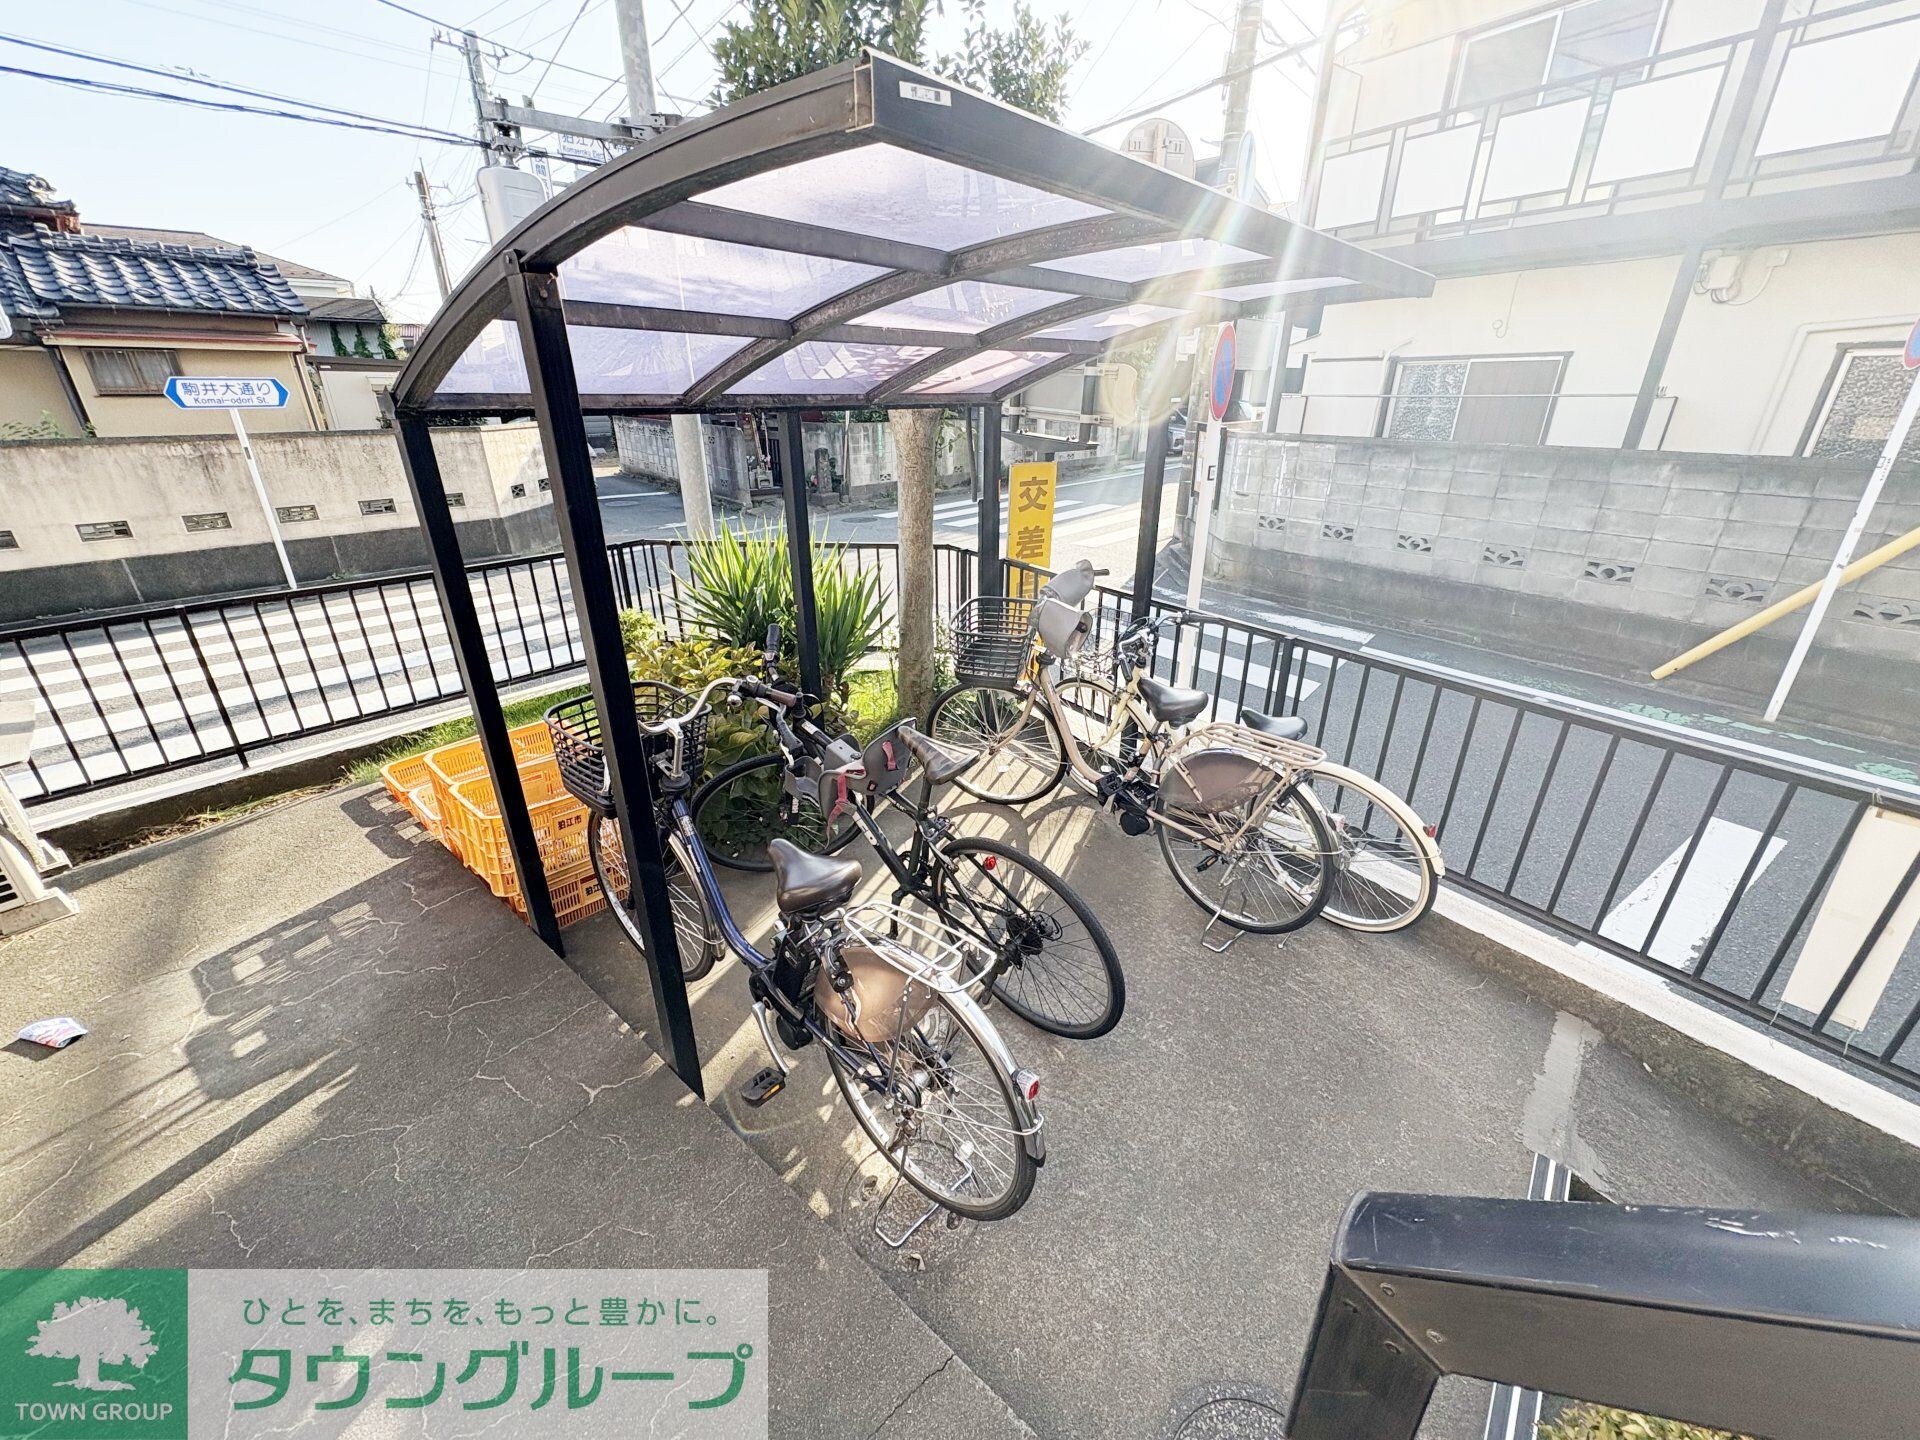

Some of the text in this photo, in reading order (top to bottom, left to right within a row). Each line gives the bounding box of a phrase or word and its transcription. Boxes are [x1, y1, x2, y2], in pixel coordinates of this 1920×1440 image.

[180, 382, 271, 396] 駒井大通り
[257, 396, 270, 404] St.
[557, 814, 582, 831] 狛江市
